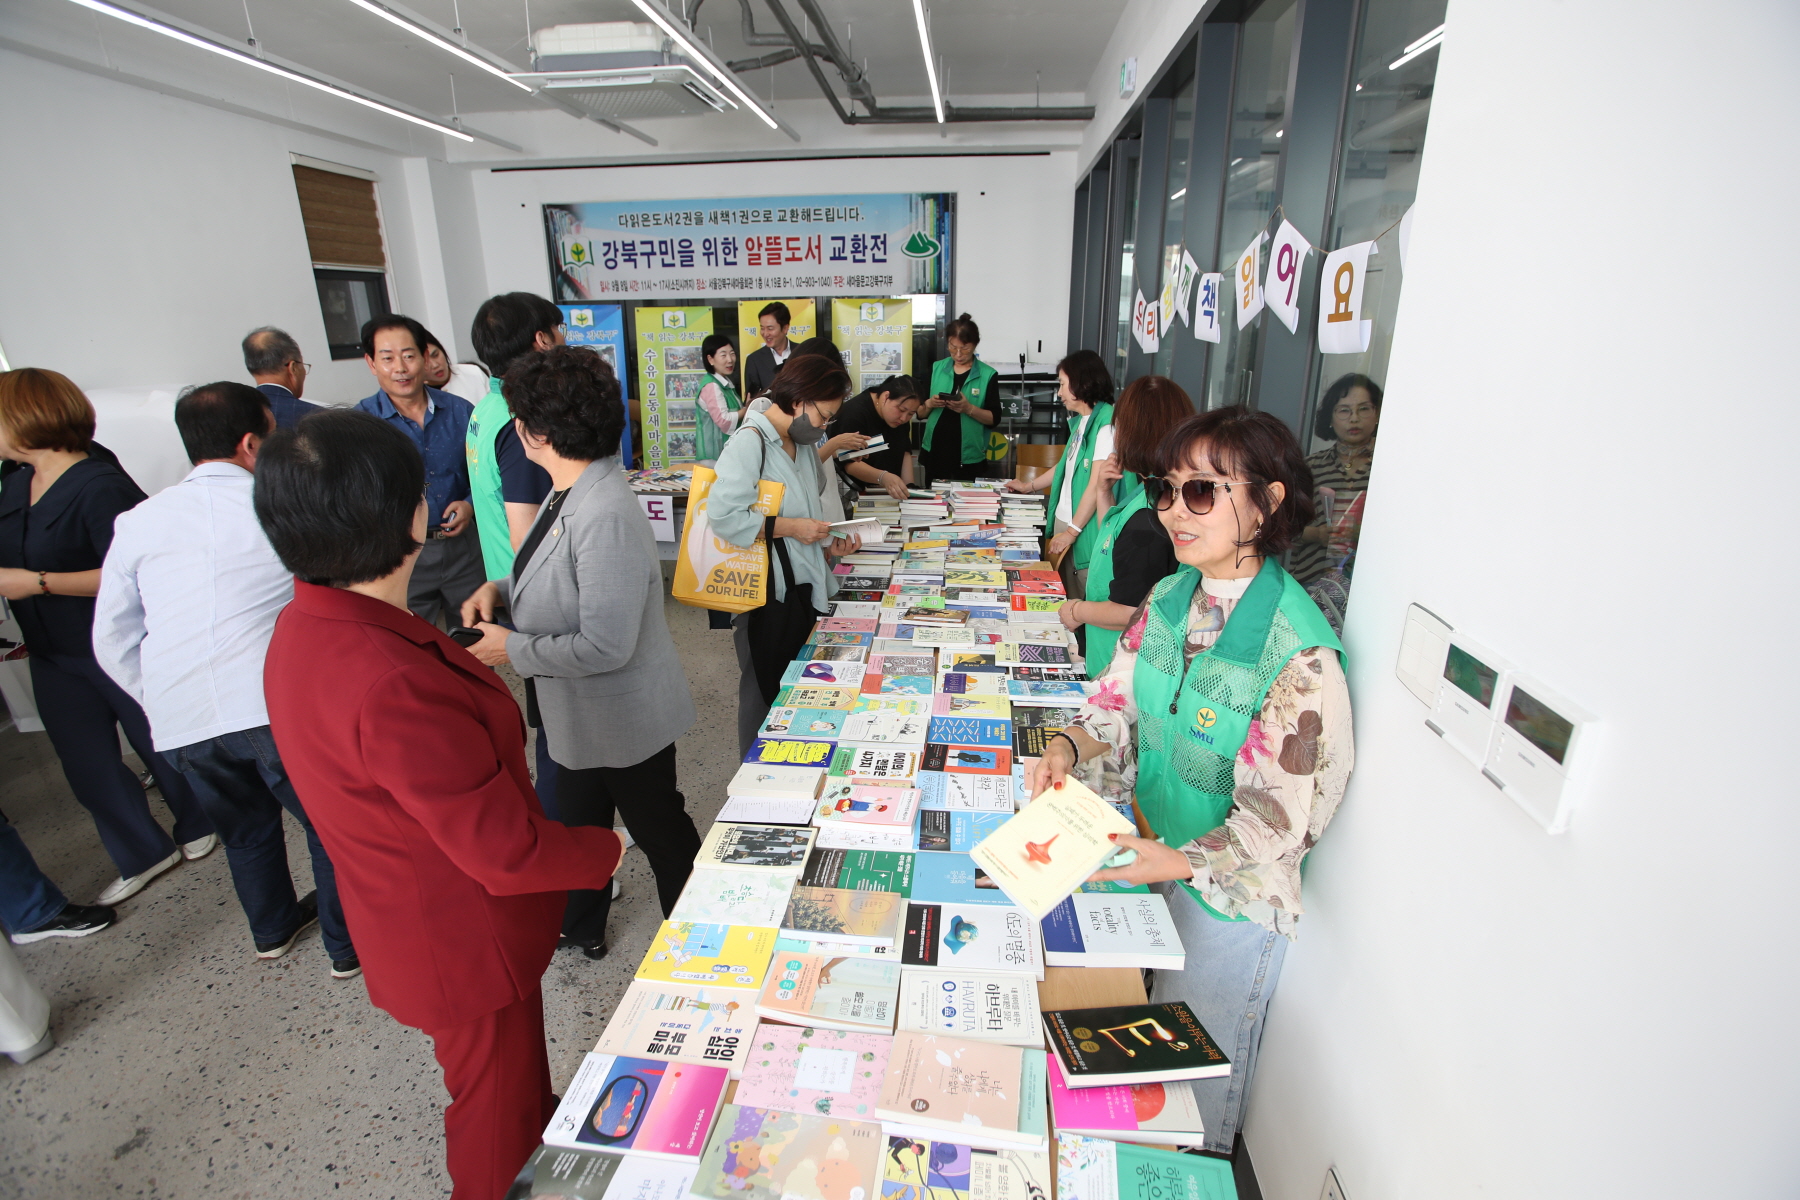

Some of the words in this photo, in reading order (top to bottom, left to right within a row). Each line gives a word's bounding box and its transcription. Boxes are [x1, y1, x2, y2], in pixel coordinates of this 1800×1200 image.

[618, 210, 704, 228] 다읽은도서2권을
[708, 208, 773, 225] 새책1권으로
[777, 206, 865, 223] 교환해드립니다.
[601, 237, 695, 270] 강북구민을
[702, 236, 738, 267] 위한
[744, 234, 822, 266] 알뜰도서
[829, 232, 888, 263] 교환전
[629, 279, 639, 292] 시간:
[641, 279, 652, 291] 11시
[696, 278, 707, 291] 장소:
[834, 275, 844, 288] 주관:
[1201, 279, 1216, 329] 책
[658, 332, 676, 342] 읽는
[854, 325, 873, 336] 읽는
[647, 500, 667, 520] 도
[725, 560, 762, 572] WATER!
[739, 552, 764, 563] SAVE
[713, 568, 760, 588] SAVE
[706, 584, 731, 596] OUR
[733, 588, 759, 599] LIFE!
[1188, 725, 1215, 746] SMU
[890, 752, 906, 771] 아이의
[972, 824, 981, 839] LIFT
[1088, 910, 1102, 931] facts
[1102, 907, 1119, 935] totality
[1136, 898, 1158, 925] 사실의
[1005, 912, 1023, 939] 6도의
[1145, 927, 1166, 947] 총체
[1005, 940, 1025, 965] 멸종
[875, 1001, 888, 1021] 명상이
[962, 980, 976, 1032] HAVRUTA
[984, 983, 1003, 1031] 하브루타
[1002, 993, 1010, 1009] 위대한
[1011, 994, 1020, 1010] 아이를
[1002, 1010, 1012, 1022] 질문
[1012, 1011, 1021, 1028] 바꾸는
[646, 1029, 670, 1055] 마음
[664, 1031, 687, 1056] 부모
[702, 1035, 723, 1061] 심리
[718, 1036, 740, 1062] 아이
[1201, 1046, 1222, 1061] 마력
[947, 1080, 959, 1096] 없다
